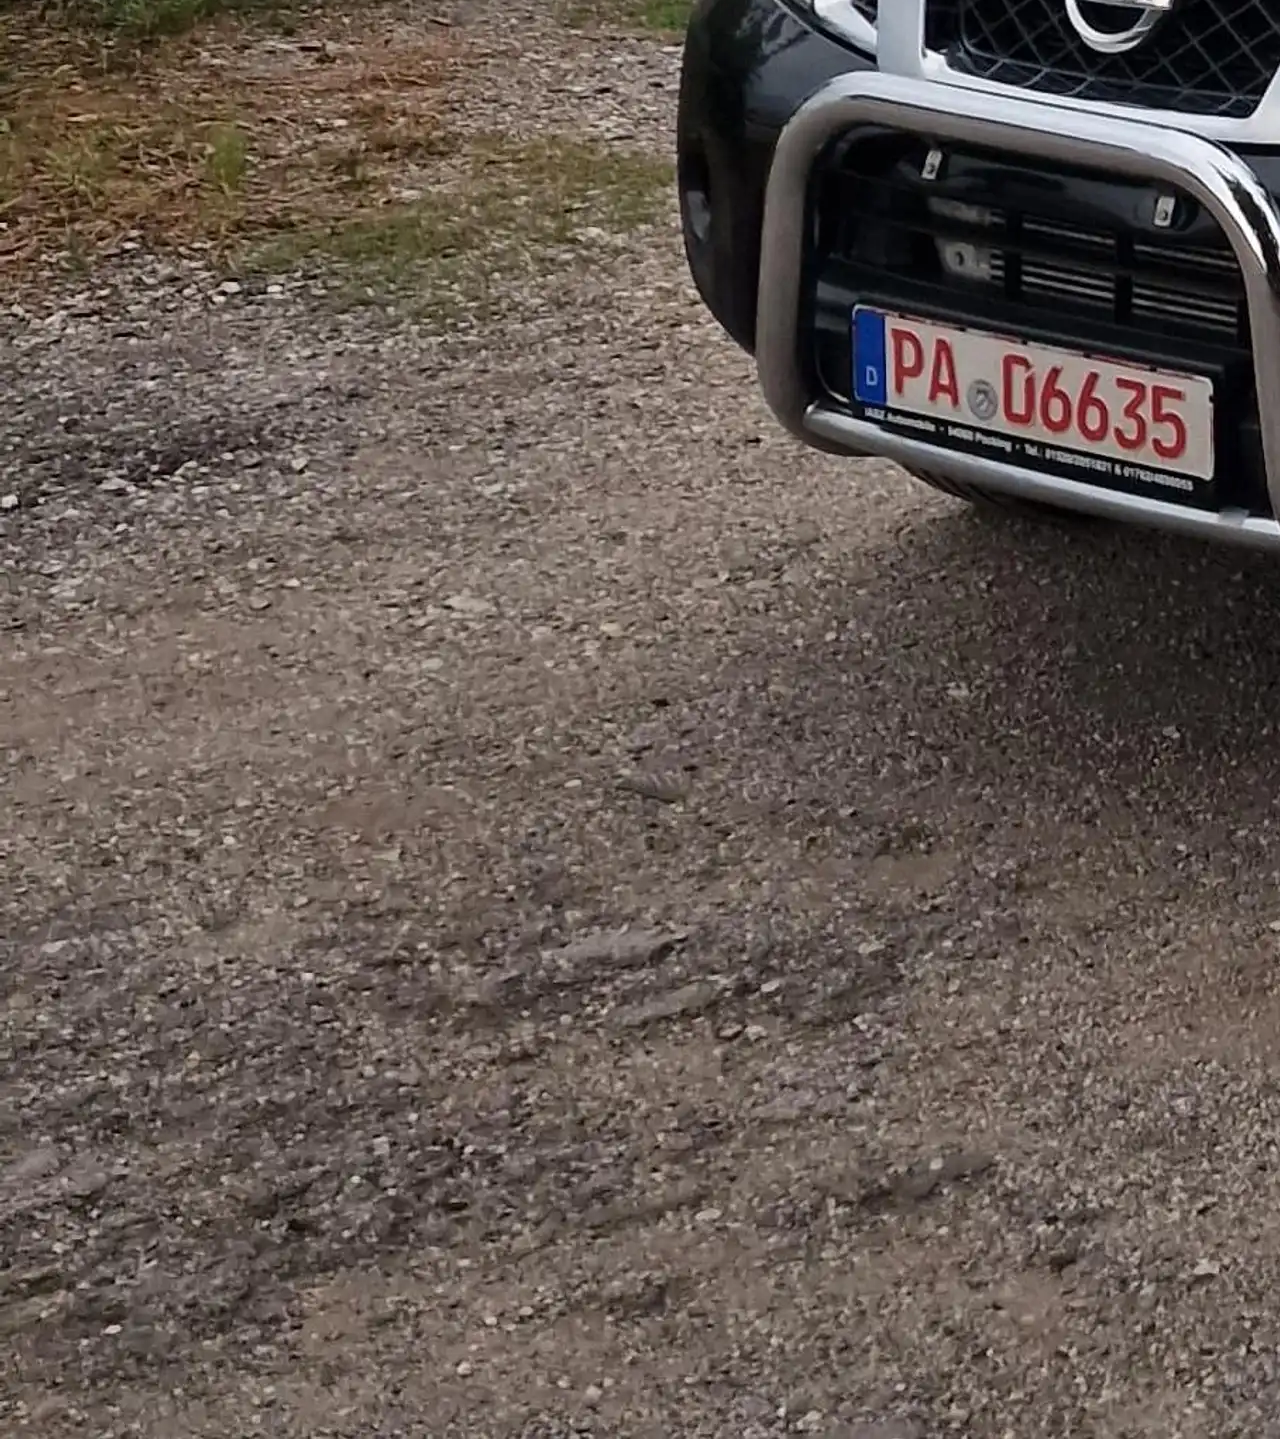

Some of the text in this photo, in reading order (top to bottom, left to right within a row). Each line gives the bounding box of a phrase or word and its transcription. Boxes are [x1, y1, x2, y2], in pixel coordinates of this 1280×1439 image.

[865, 328, 1188, 460] D PA 06635
